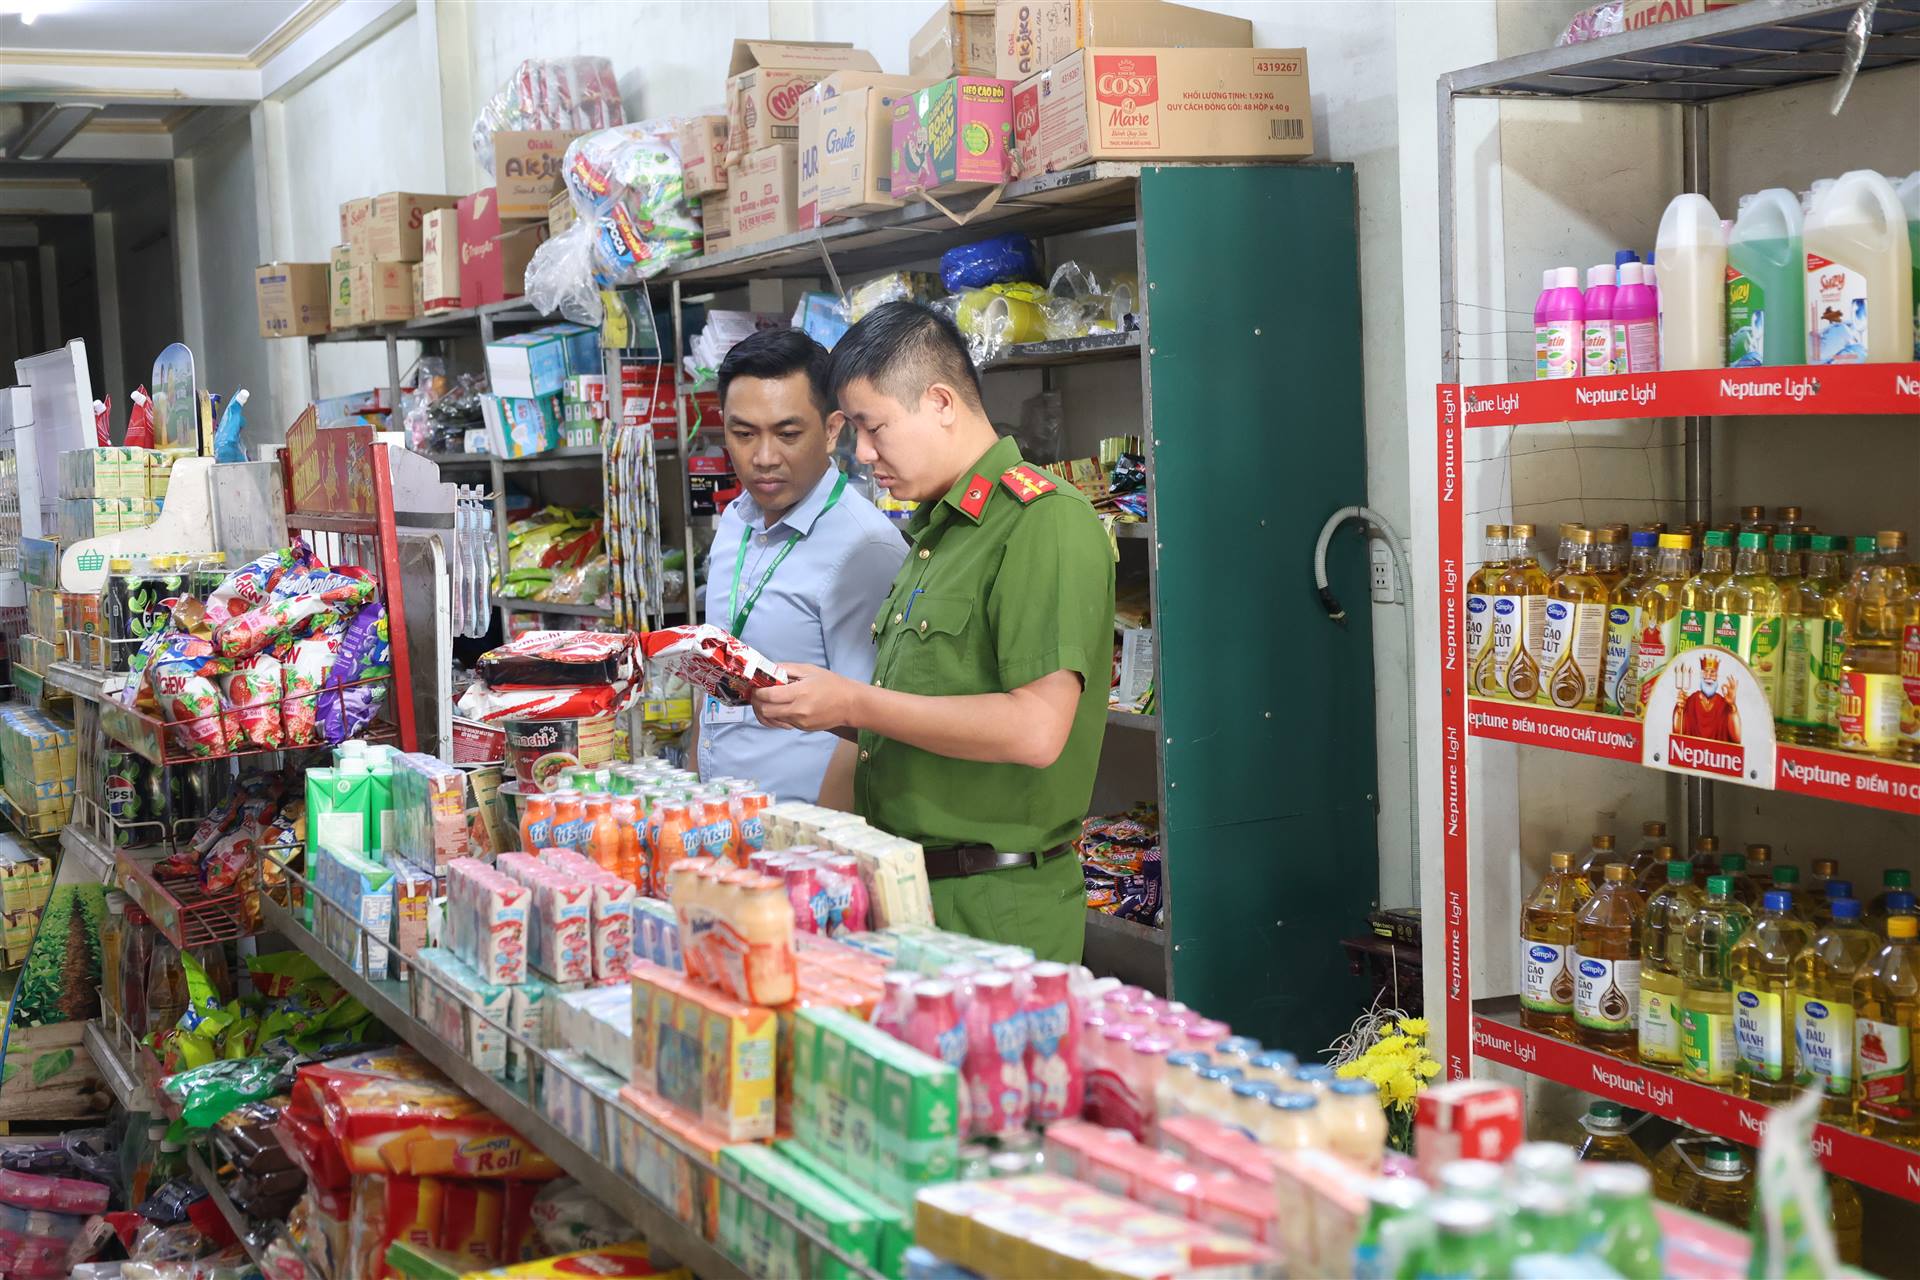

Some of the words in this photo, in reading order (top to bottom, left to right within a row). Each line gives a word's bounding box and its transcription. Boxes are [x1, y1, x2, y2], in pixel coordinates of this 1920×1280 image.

[1257, 62, 1297, 72] 4319267
[977, 86, 992, 97] CAO
[1098, 74, 1153, 96] COSY
[1167, 103, 1182, 111] QUY
[1017, 107, 1038, 131] COSY
[1108, 109, 1150, 128] Marie
[802, 145, 819, 182] HUR
[606, 219, 627, 256] POCA
[1820, 273, 1845, 293] Suzy
[1576, 387, 1628, 406] Neptune
[1631, 383, 1656, 405] Light
[1720, 378, 1781, 400] Neptune
[1496, 393, 1519, 415] Light
[1444, 428, 1456, 501] Neptune
[1445, 559, 1457, 595] Light
[1495, 601, 1514, 613] Simply
[1547, 606, 1567, 618] Simply
[1610, 610, 1630, 622] Simply
[1446, 599, 1456, 670] Neptune
[1469, 712, 1509, 729] eptune
[1512, 716, 1536, 734] ĐIỂM
[1537, 723, 1549, 735] 10
[1549, 725, 1570, 738] CHO
[1571, 726, 1597, 742] CHẤT
[1448, 727, 1459, 760] Light
[1671, 739, 1742, 772] Neptune
[1782, 759, 1850, 788] Neptune
[1855, 774, 1889, 794] ĐIỂM
[1892, 783, 1907, 797] 10
[1448, 765, 1459, 836] Neptune
[1450, 892, 1461, 925] Light
[1532, 949, 1557, 961] Simply
[1581, 963, 1605, 976] Simply
[1514, 1040, 1536, 1062] Light
[1592, 1064, 1645, 1096] Neptune
[1648, 1081, 1674, 1105] Light
[478, 1150, 520, 1171] Roll
